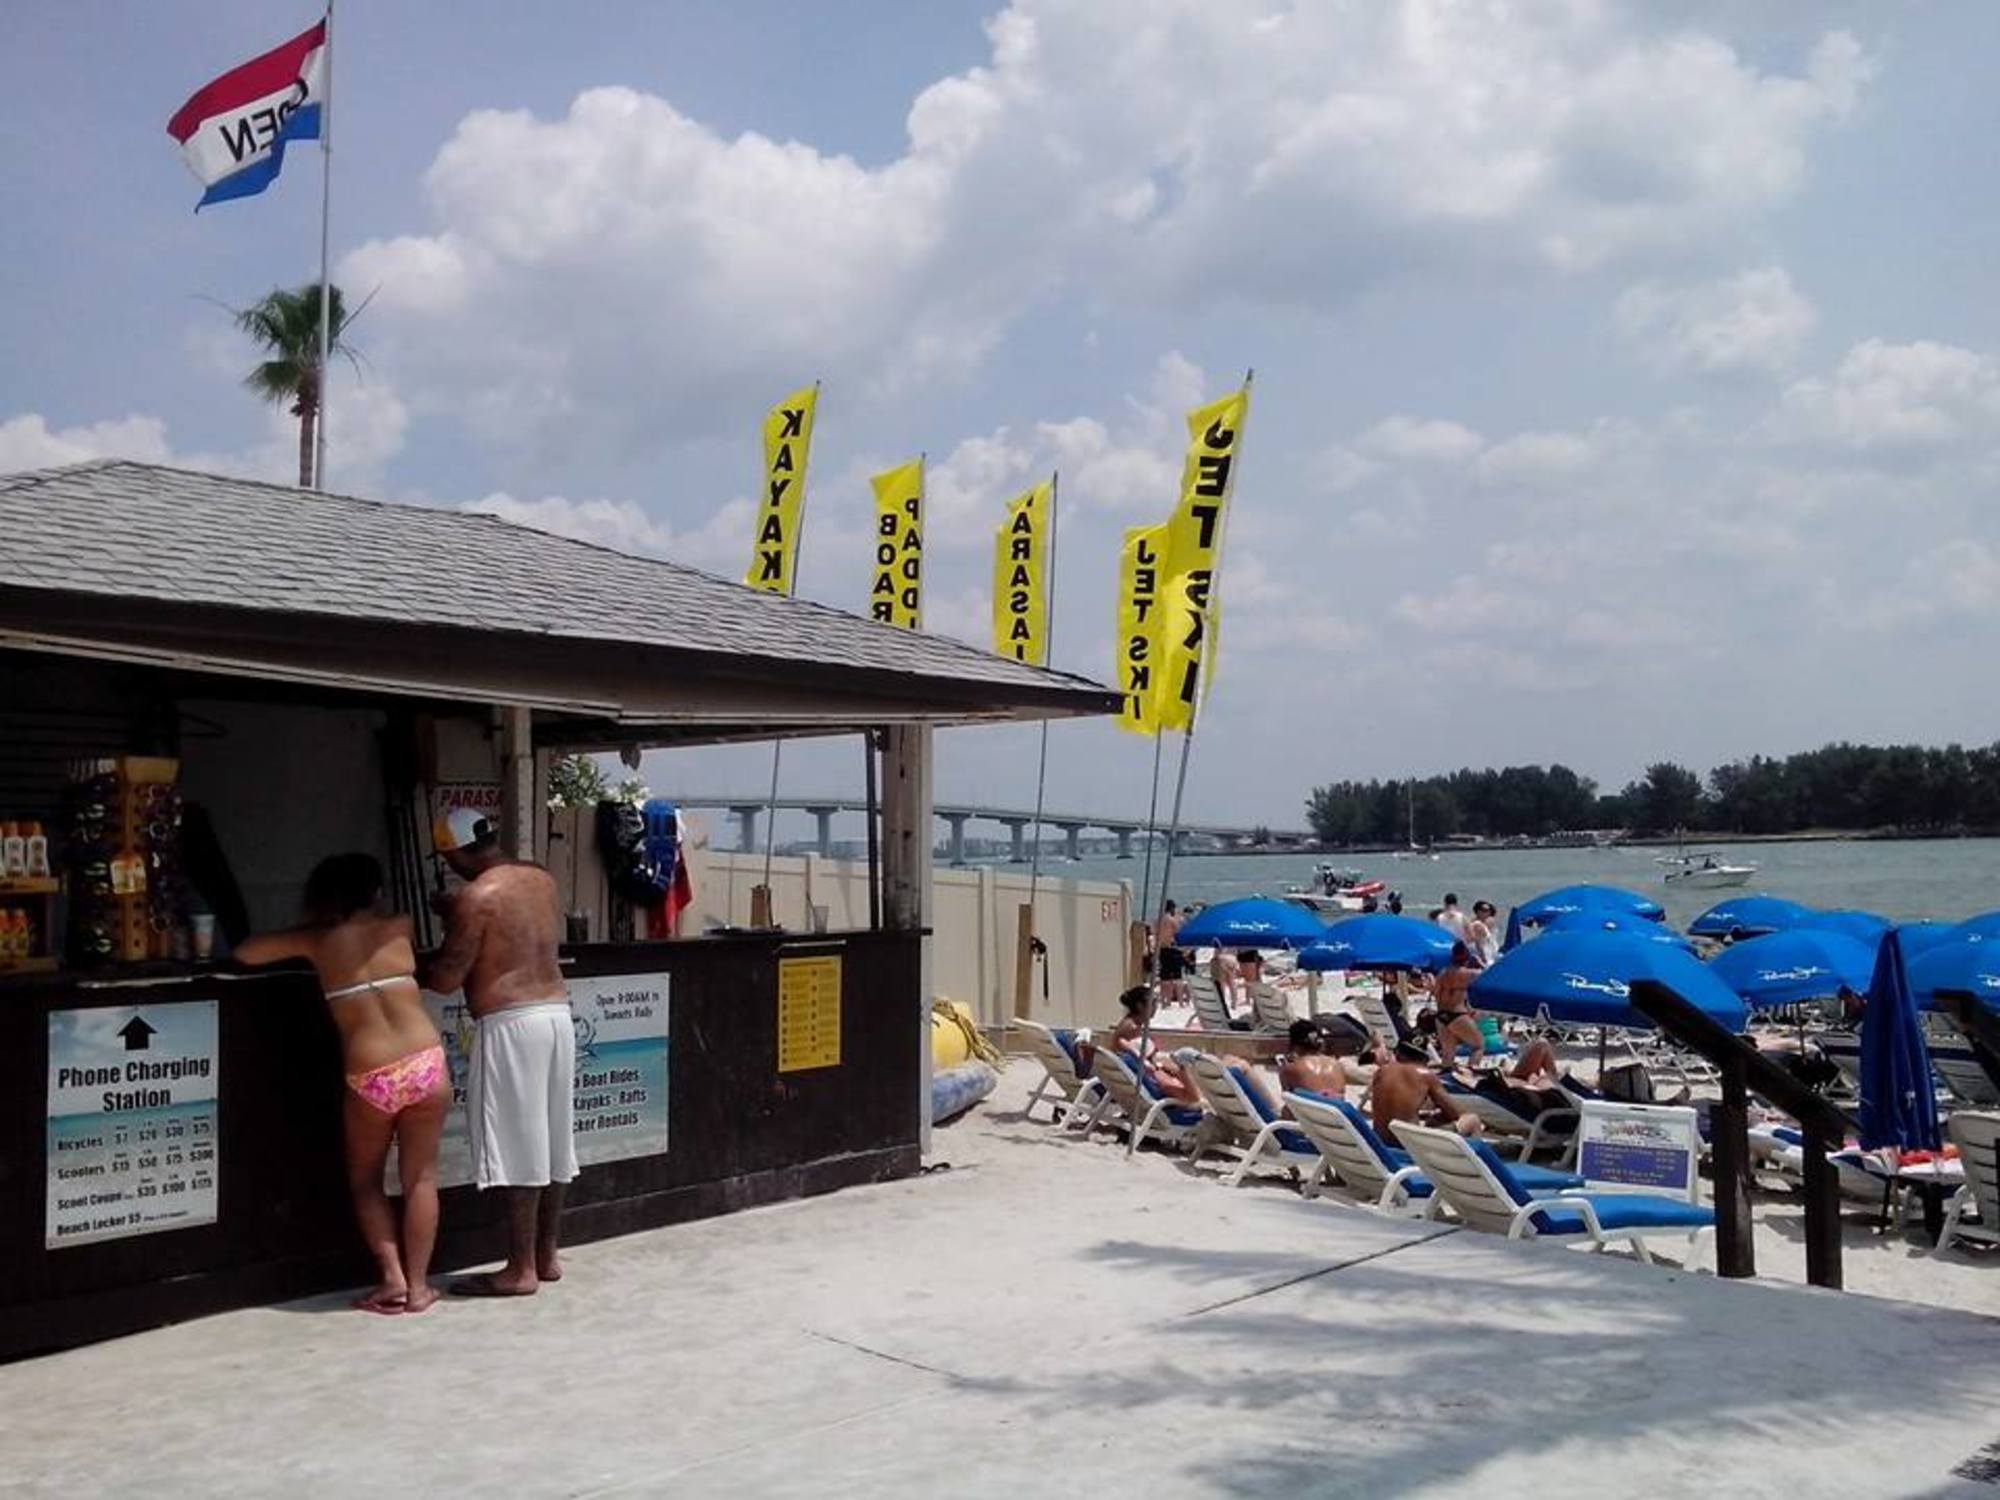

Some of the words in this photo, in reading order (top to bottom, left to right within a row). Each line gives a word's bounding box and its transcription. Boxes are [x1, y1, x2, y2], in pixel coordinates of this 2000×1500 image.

[58, 1066, 121, 1088] Phone
[126, 1056, 210, 1082] Charging
[583, 1072, 607, 1088] Boat
[610, 1069, 638, 1084] Rides
[103, 1088, 171, 1112] Station
[598, 1111, 638, 1130] Rentals
[57, 1164, 105, 1180] Scooters
[57, 1220, 90, 1237] Beach
[93, 1214, 126, 1231] Locker
